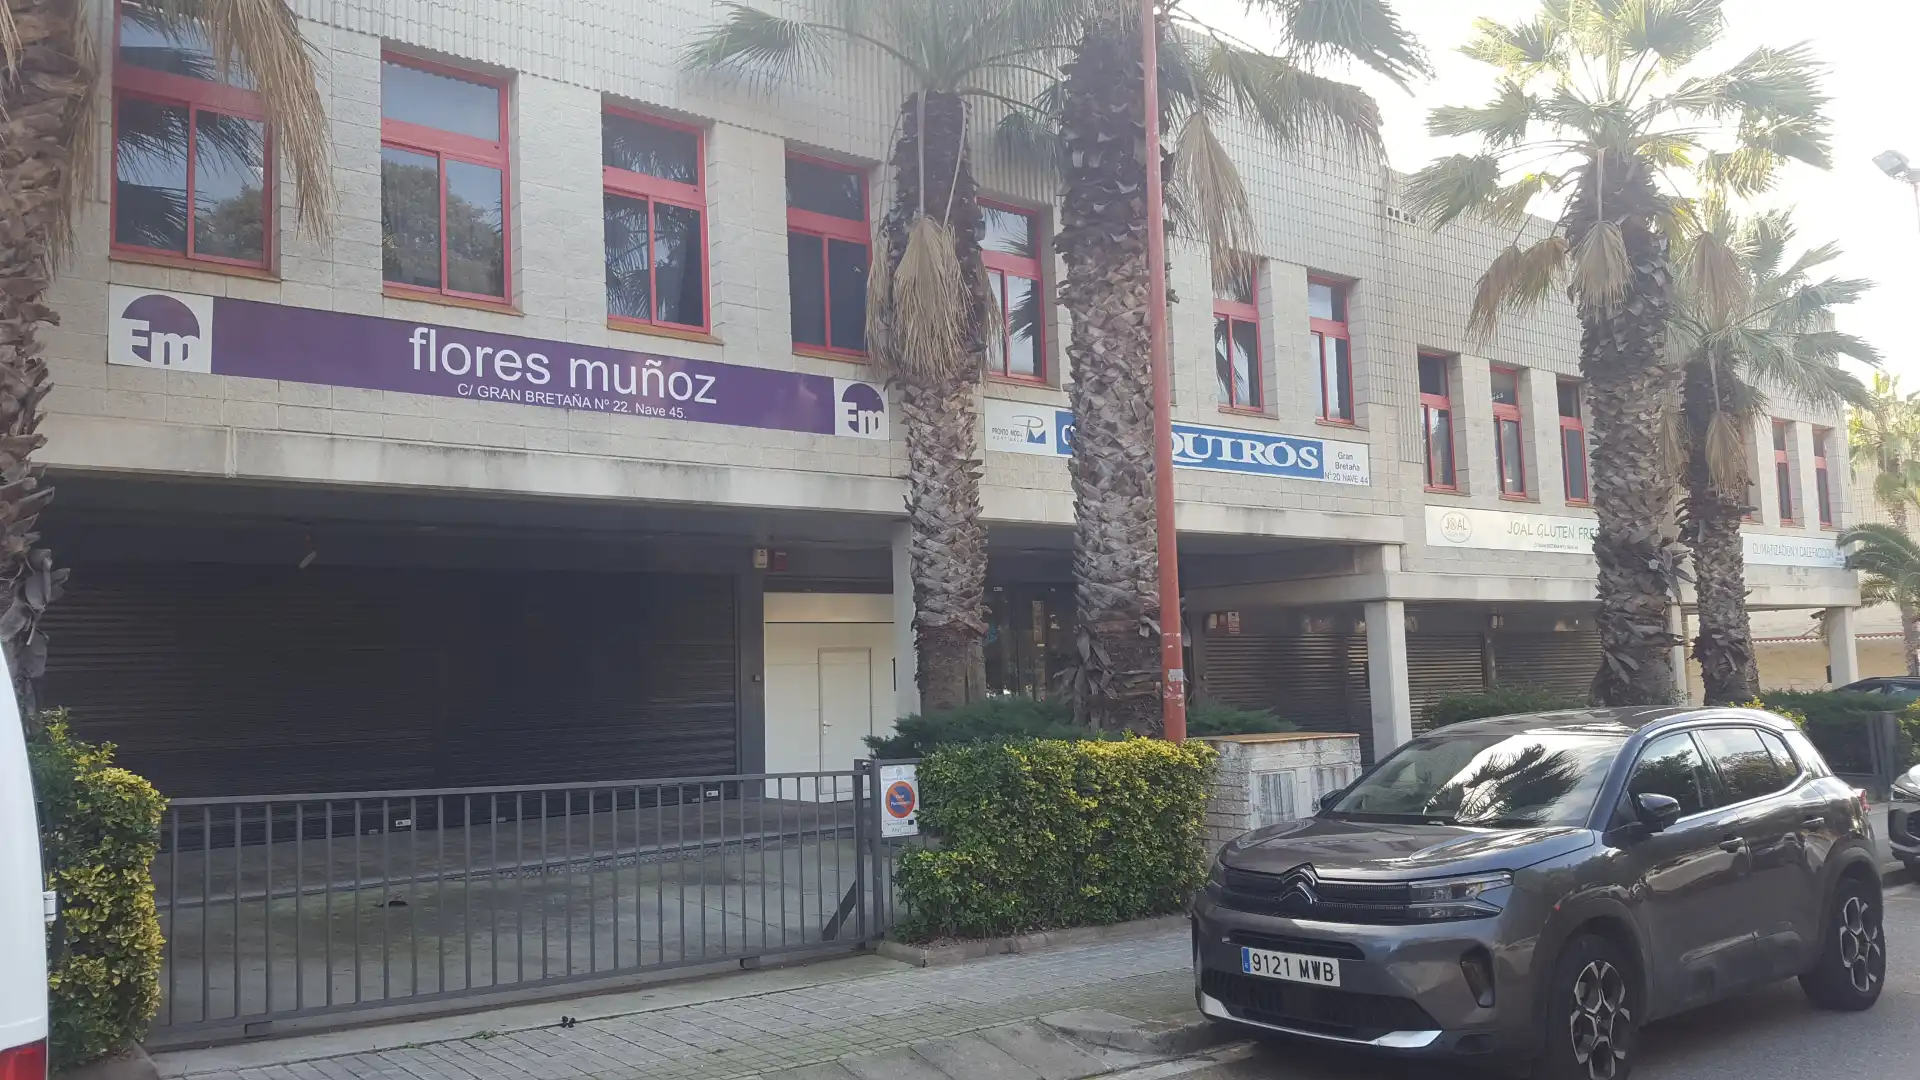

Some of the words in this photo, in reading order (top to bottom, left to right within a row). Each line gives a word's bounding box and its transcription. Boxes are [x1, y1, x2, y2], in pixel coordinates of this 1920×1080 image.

[408, 327, 552, 385] flores
[569, 359, 717, 405] muñoz
[457, 383, 474, 397] C/
[477, 386, 522, 402] GRAN
[525, 391, 592, 409] BRETAÑA
[613, 400, 632, 413] 22.
[636, 403, 666, 417] Nave
[669, 407, 687, 419] 45.
[991, 427, 1009, 436] PRONTO
[1337, 451, 1354, 461] Gran
[1334, 461, 1361, 472] Bretaña
[1333, 473, 1341, 481] 20
[1342, 474, 1359, 483] NAVE
[1360, 476, 1369, 484] 44
[1506, 524, 1534, 537] JOAL
[1536, 523, 1575, 539] GLUTEN
[1252, 953, 1290, 977] 9121
[1298, 958, 1334, 982] MWB
